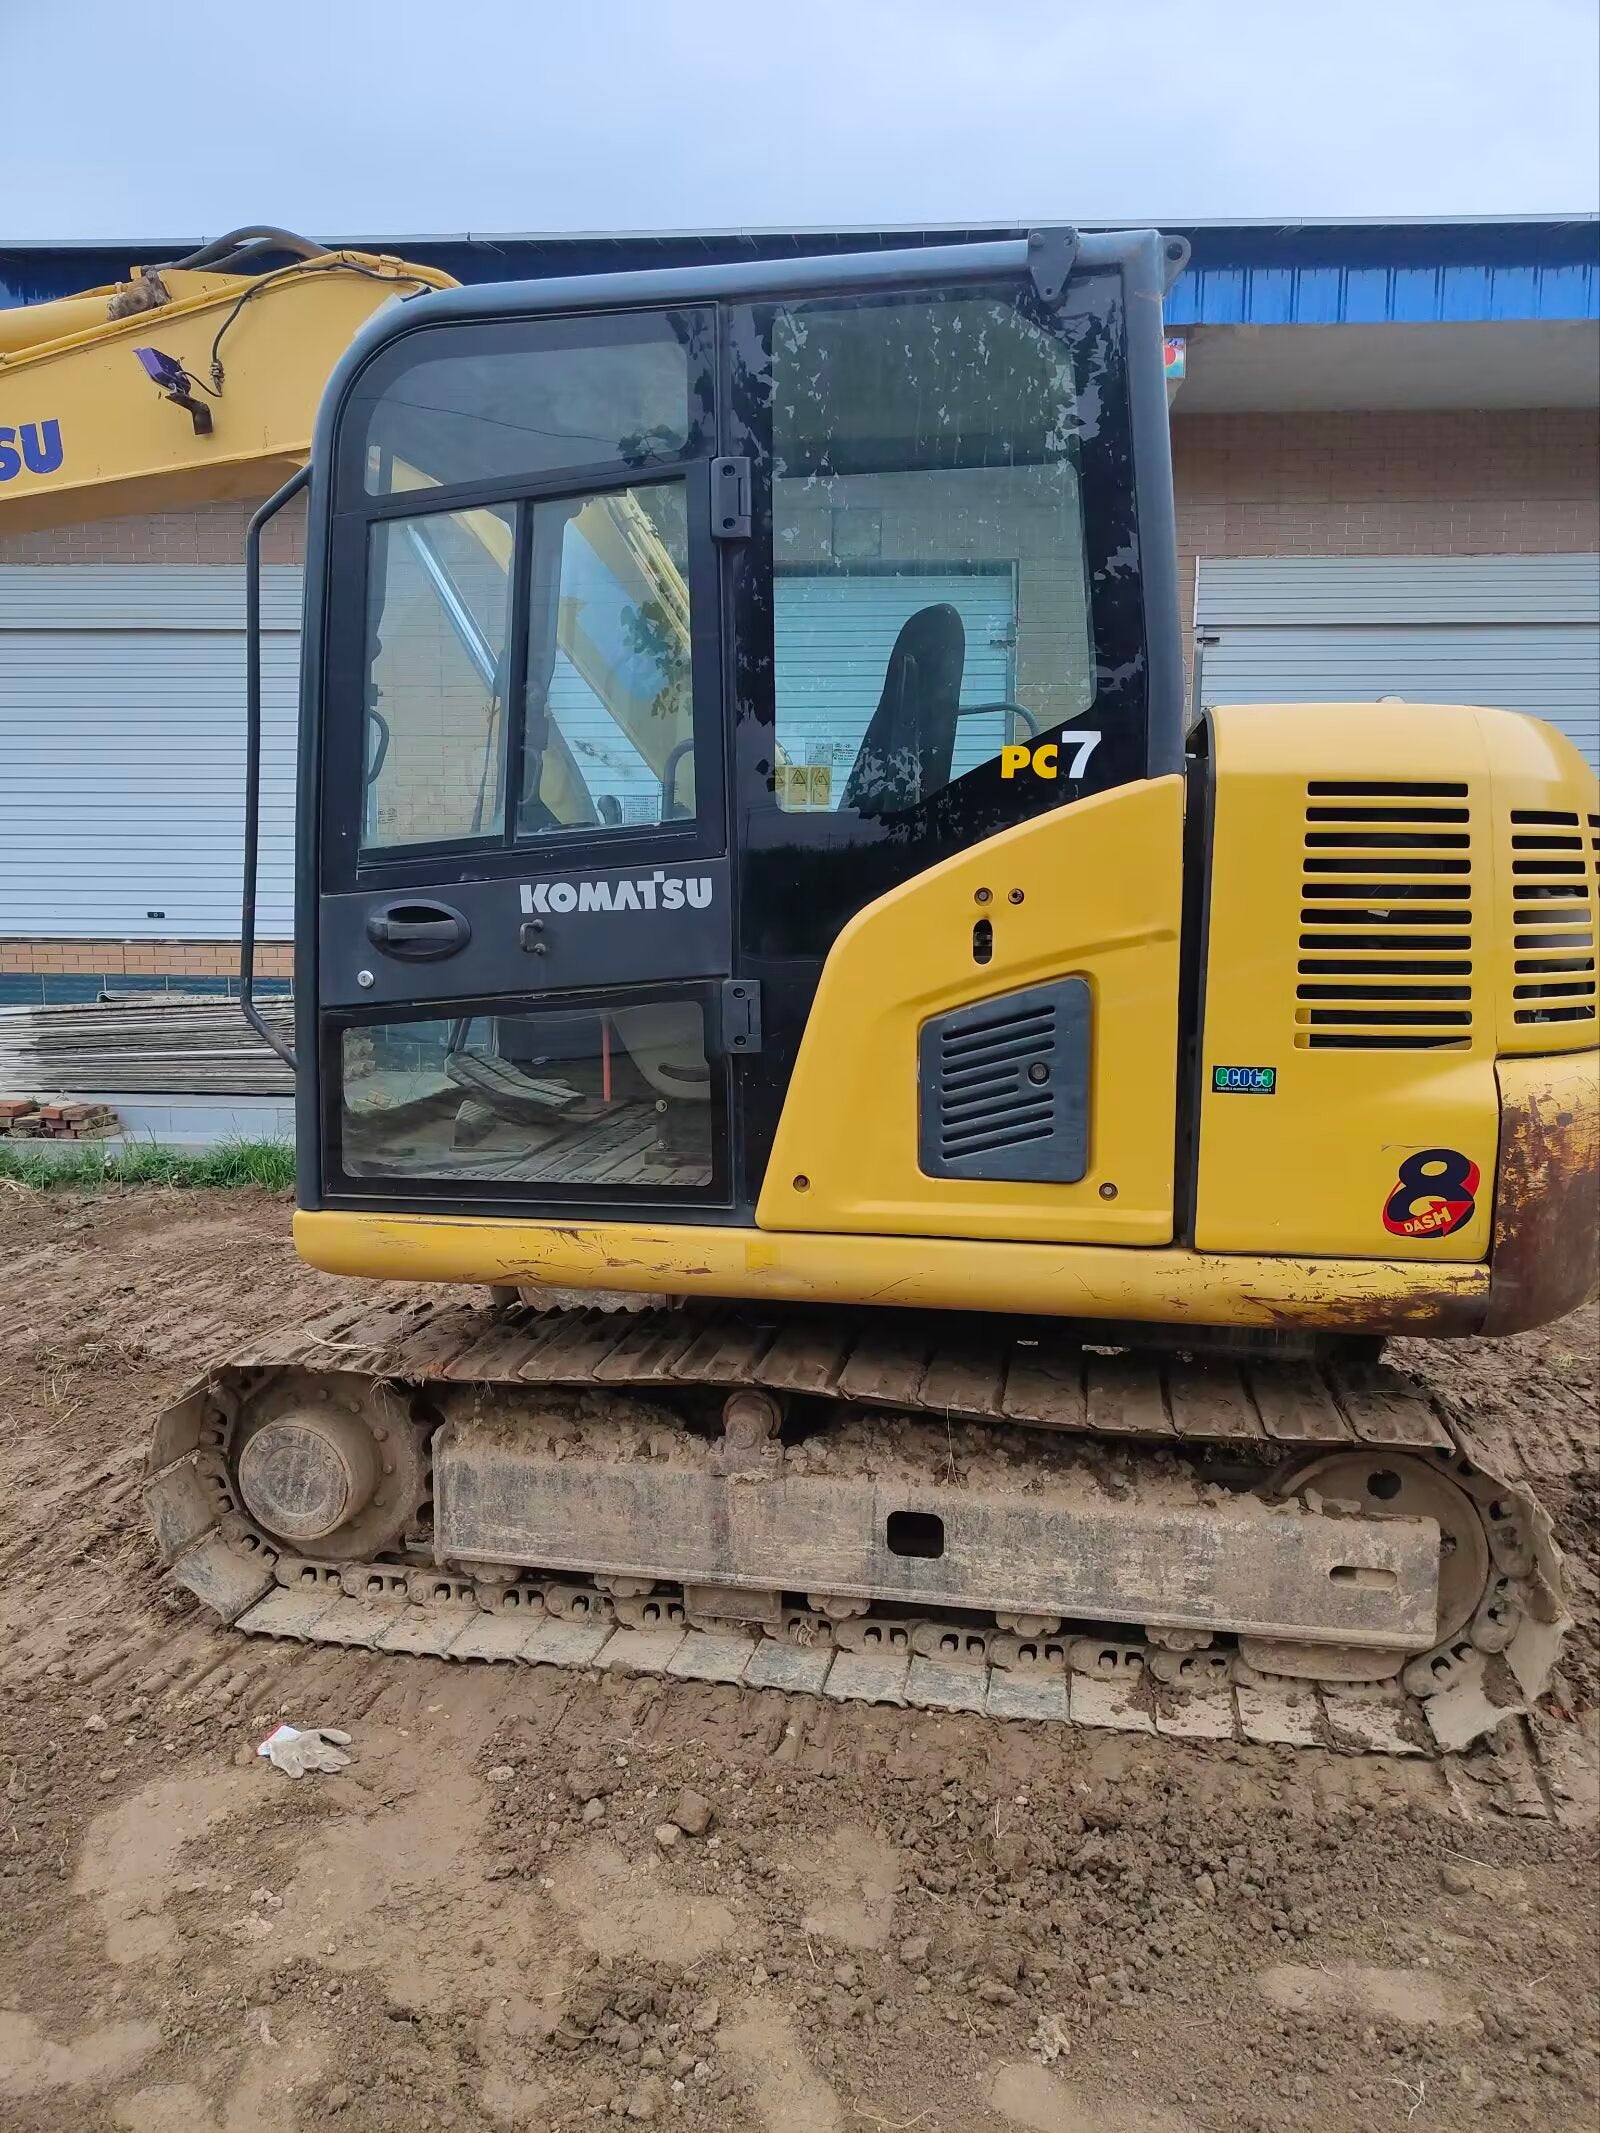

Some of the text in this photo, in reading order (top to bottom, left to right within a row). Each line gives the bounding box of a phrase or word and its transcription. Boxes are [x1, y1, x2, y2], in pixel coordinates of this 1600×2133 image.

[519, 870, 713, 914] KOMATSU
[1216, 1068, 1274, 1087] ecot3
[1387, 1149, 1475, 1238] 8
[1403, 1207, 1451, 1233] DASH
